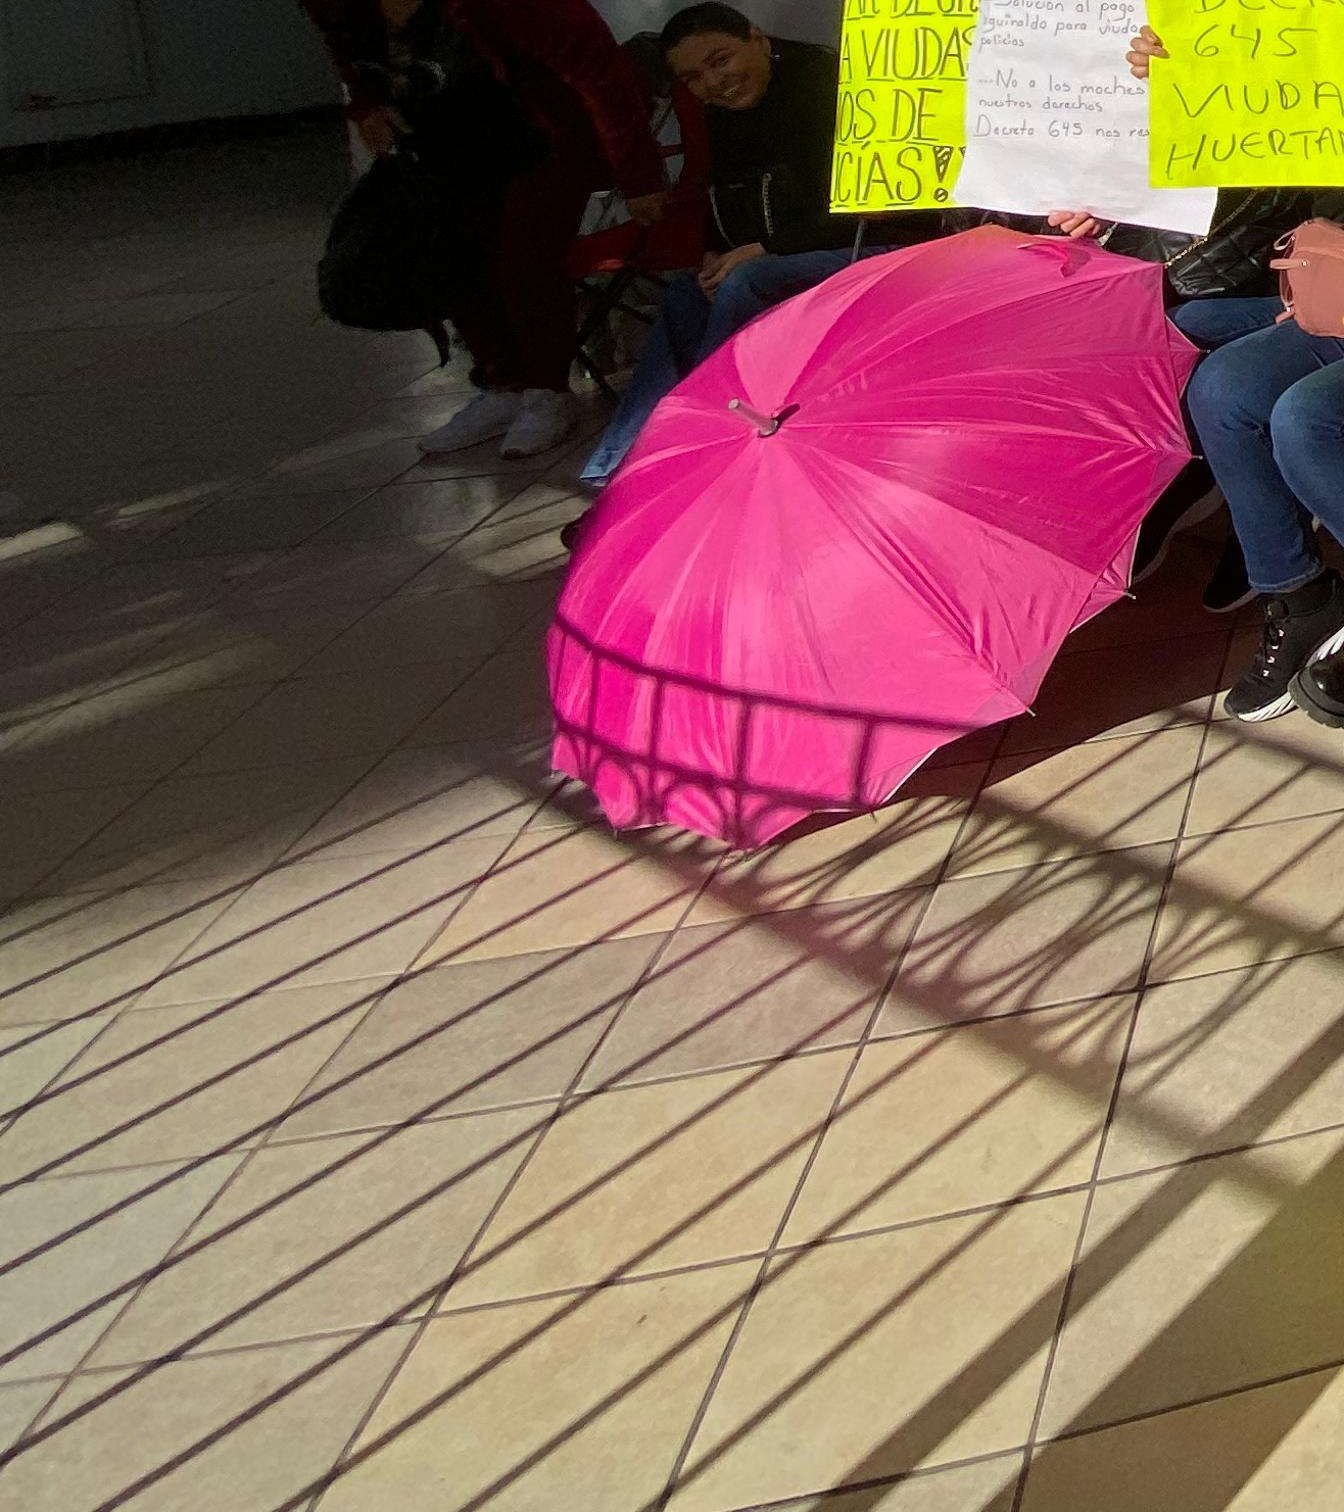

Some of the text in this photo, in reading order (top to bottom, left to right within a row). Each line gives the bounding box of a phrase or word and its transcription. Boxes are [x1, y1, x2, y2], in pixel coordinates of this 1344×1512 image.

[1193, 23, 1318, 60] 645
[1049, 74, 1072, 93] los
[1080, 76, 1146, 96] moches
[837, 88, 943, 143] OS DE
[973, 114, 1035, 138] Decreto
[1049, 119, 1084, 138] 645
